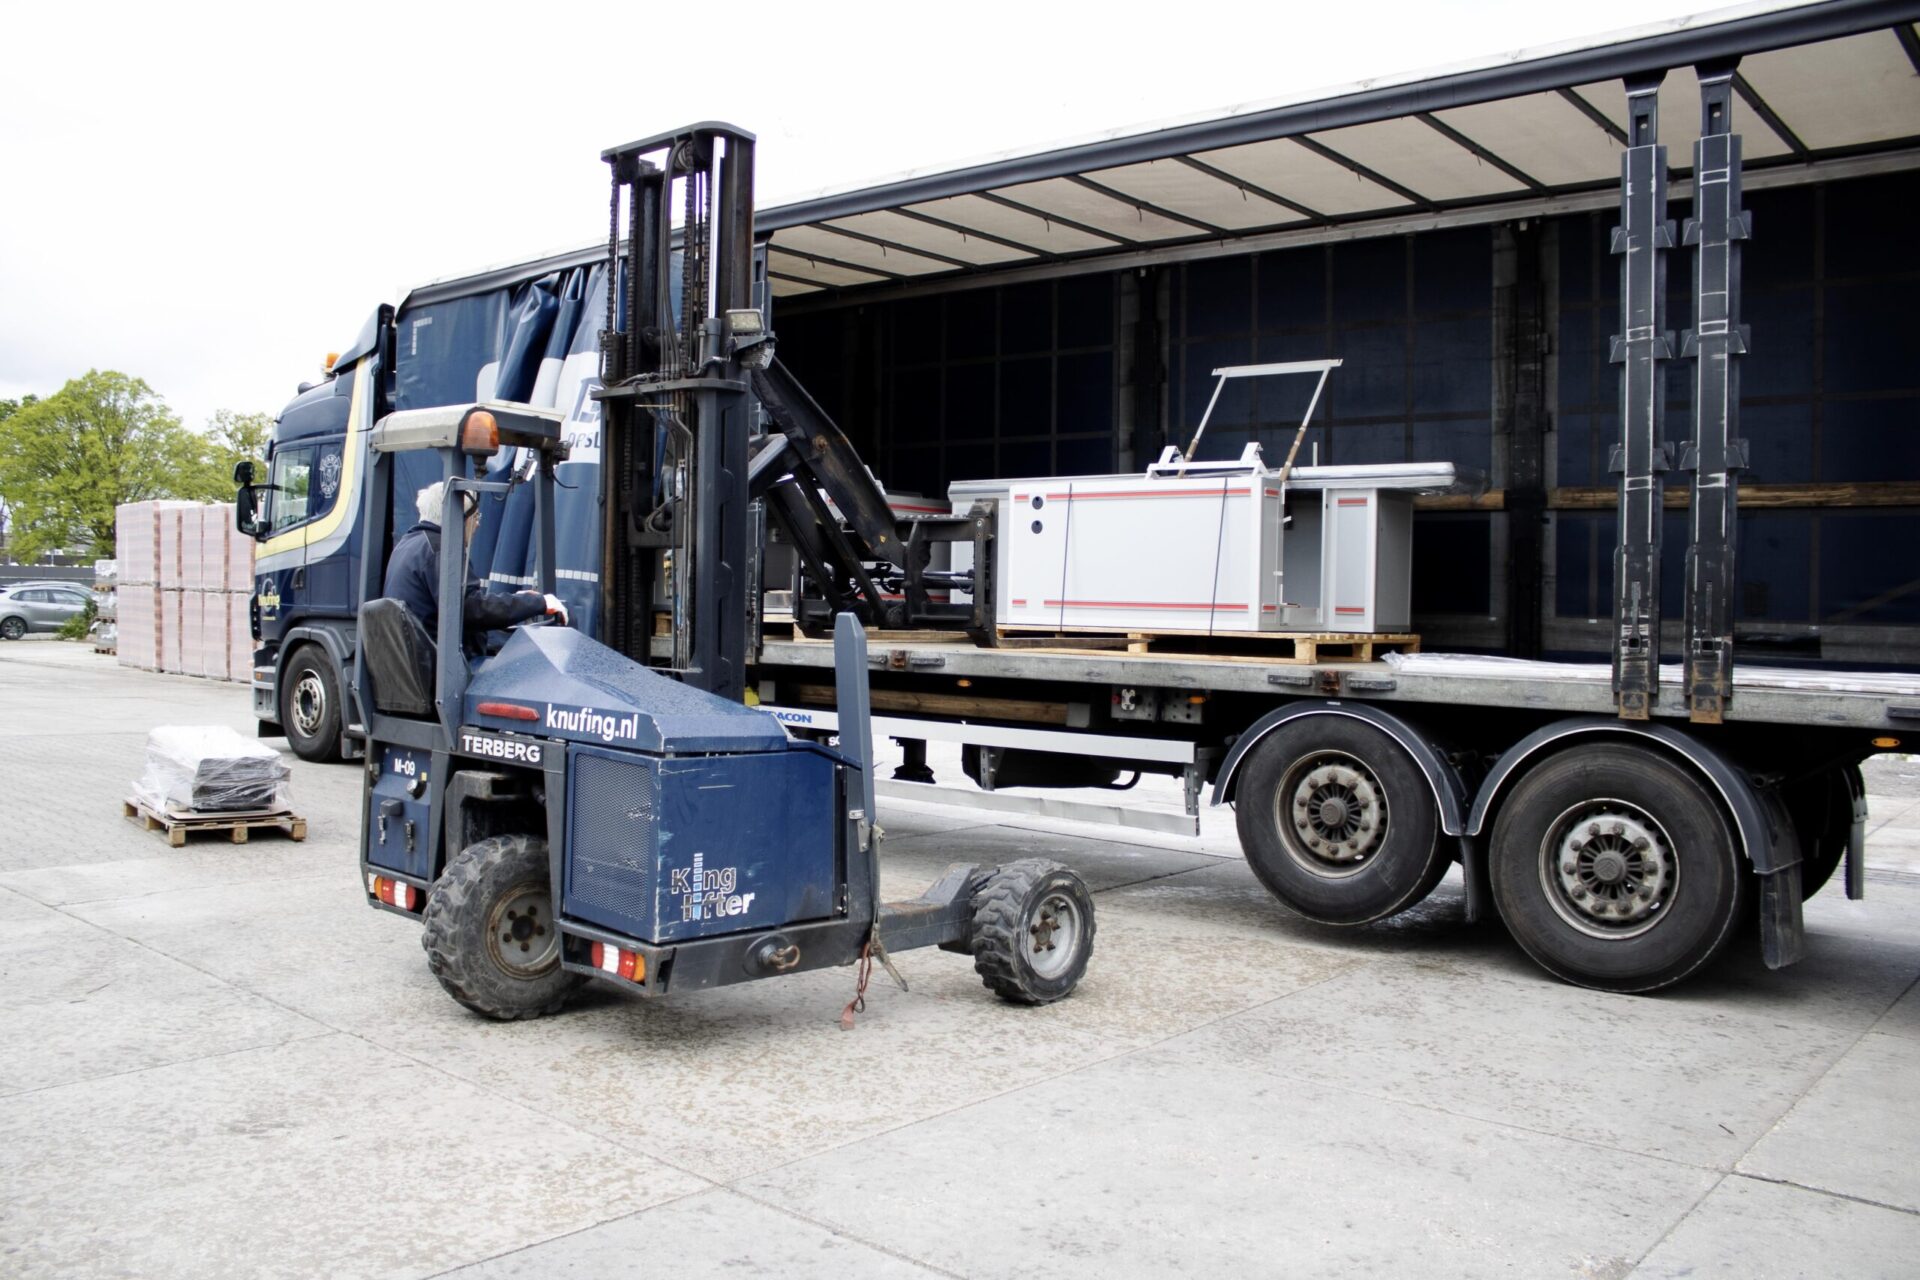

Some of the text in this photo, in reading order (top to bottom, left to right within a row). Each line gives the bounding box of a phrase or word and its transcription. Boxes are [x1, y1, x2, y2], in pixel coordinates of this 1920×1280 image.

[546, 703, 639, 741] knufing.nl
[462, 734, 541, 763] TERBERG
[394, 758, 416, 776] M-09
[671, 856, 737, 894] King
